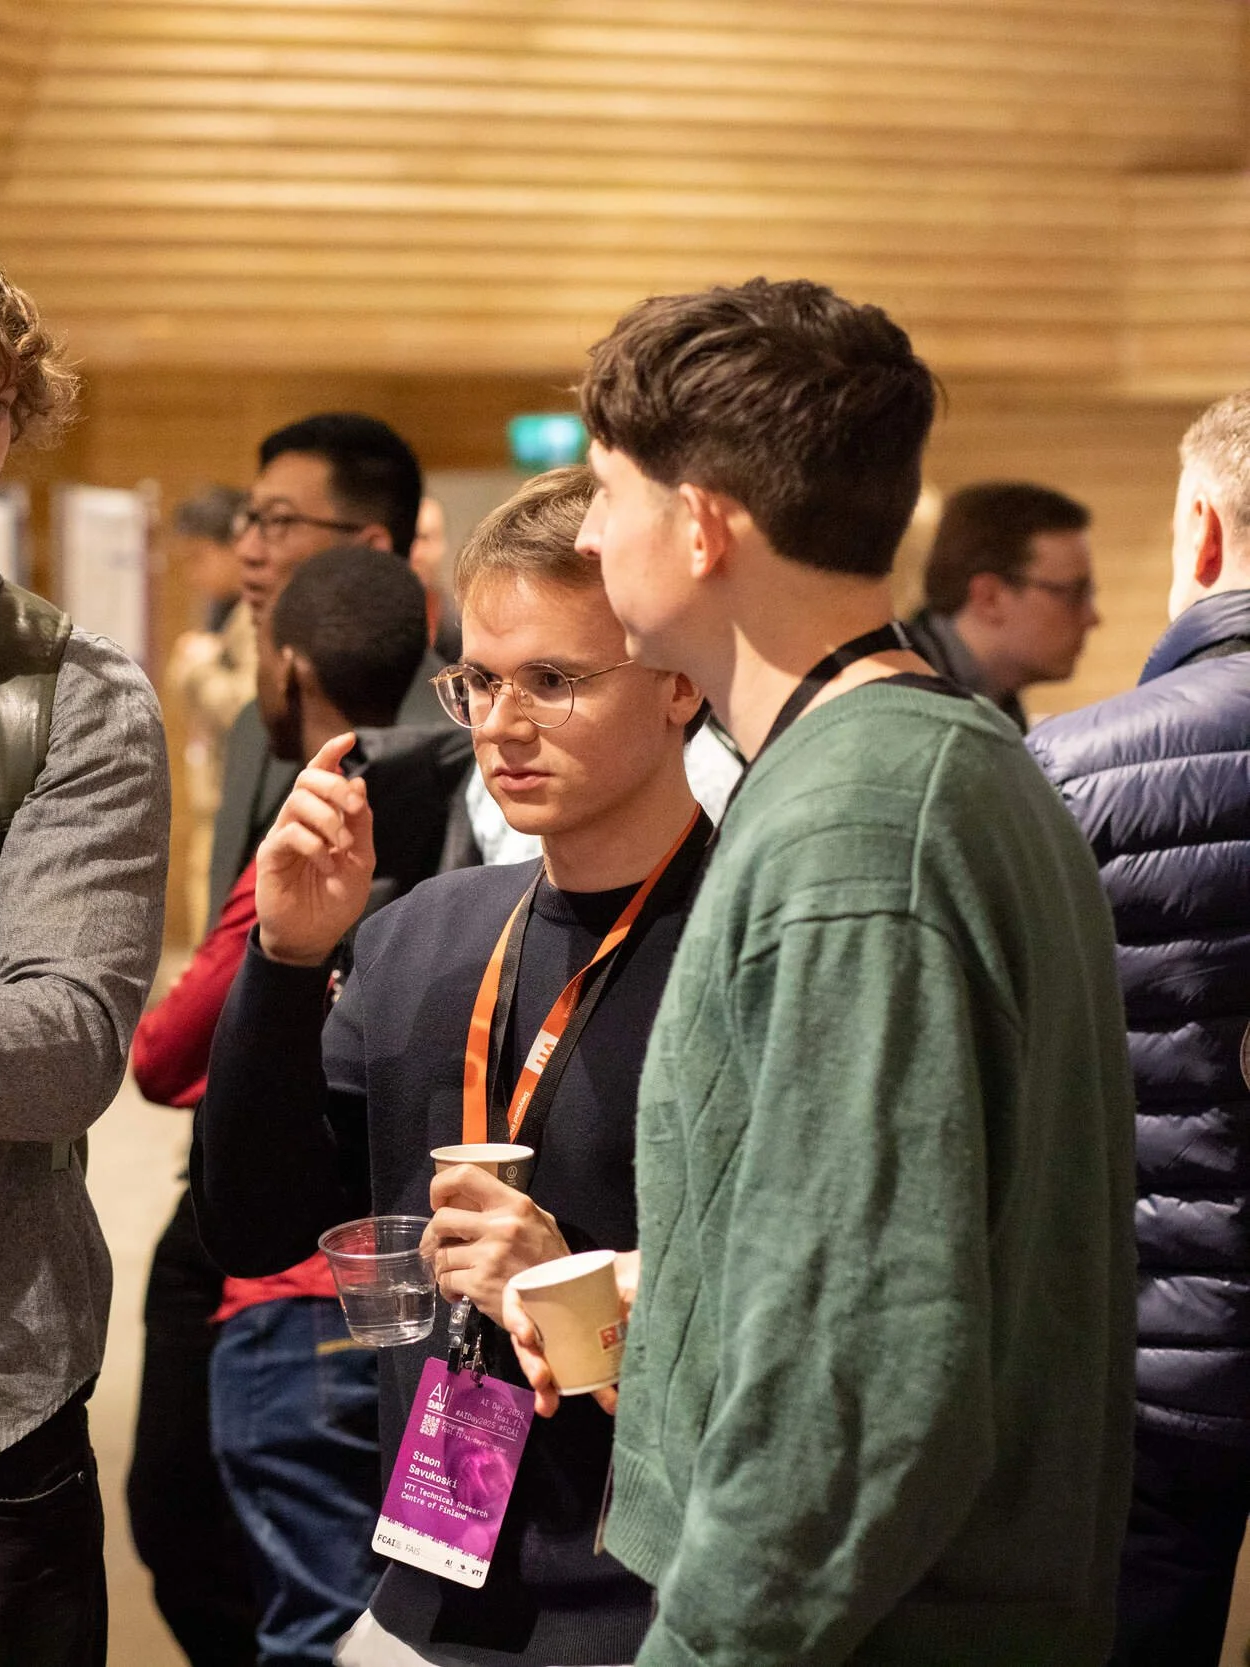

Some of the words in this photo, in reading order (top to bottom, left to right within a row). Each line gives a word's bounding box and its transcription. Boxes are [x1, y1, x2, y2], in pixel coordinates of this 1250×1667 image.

[513, 1091, 530, 1121] beyond
[429, 1382, 449, 1402] AI
[427, 1400, 445, 1412] DAY
[492, 1402, 503, 1414] Day
[508, 1408, 525, 1419] 2025
[455, 1409, 495, 1429] #AIDay2025
[412, 1450, 441, 1468] Simon
[408, 1463, 458, 1489] Savukoski
[401, 1491, 425, 1505] Centre
[427, 1501, 437, 1509] of
[439, 1505, 467, 1520] Finland
[404, 1482, 416, 1492] VTT
[419, 1487, 454, 1506] Technical
[457, 1501, 488, 1518] Research
[377, 1534, 396, 1547] FCAI
[471, 1568, 484, 1578] VTT
